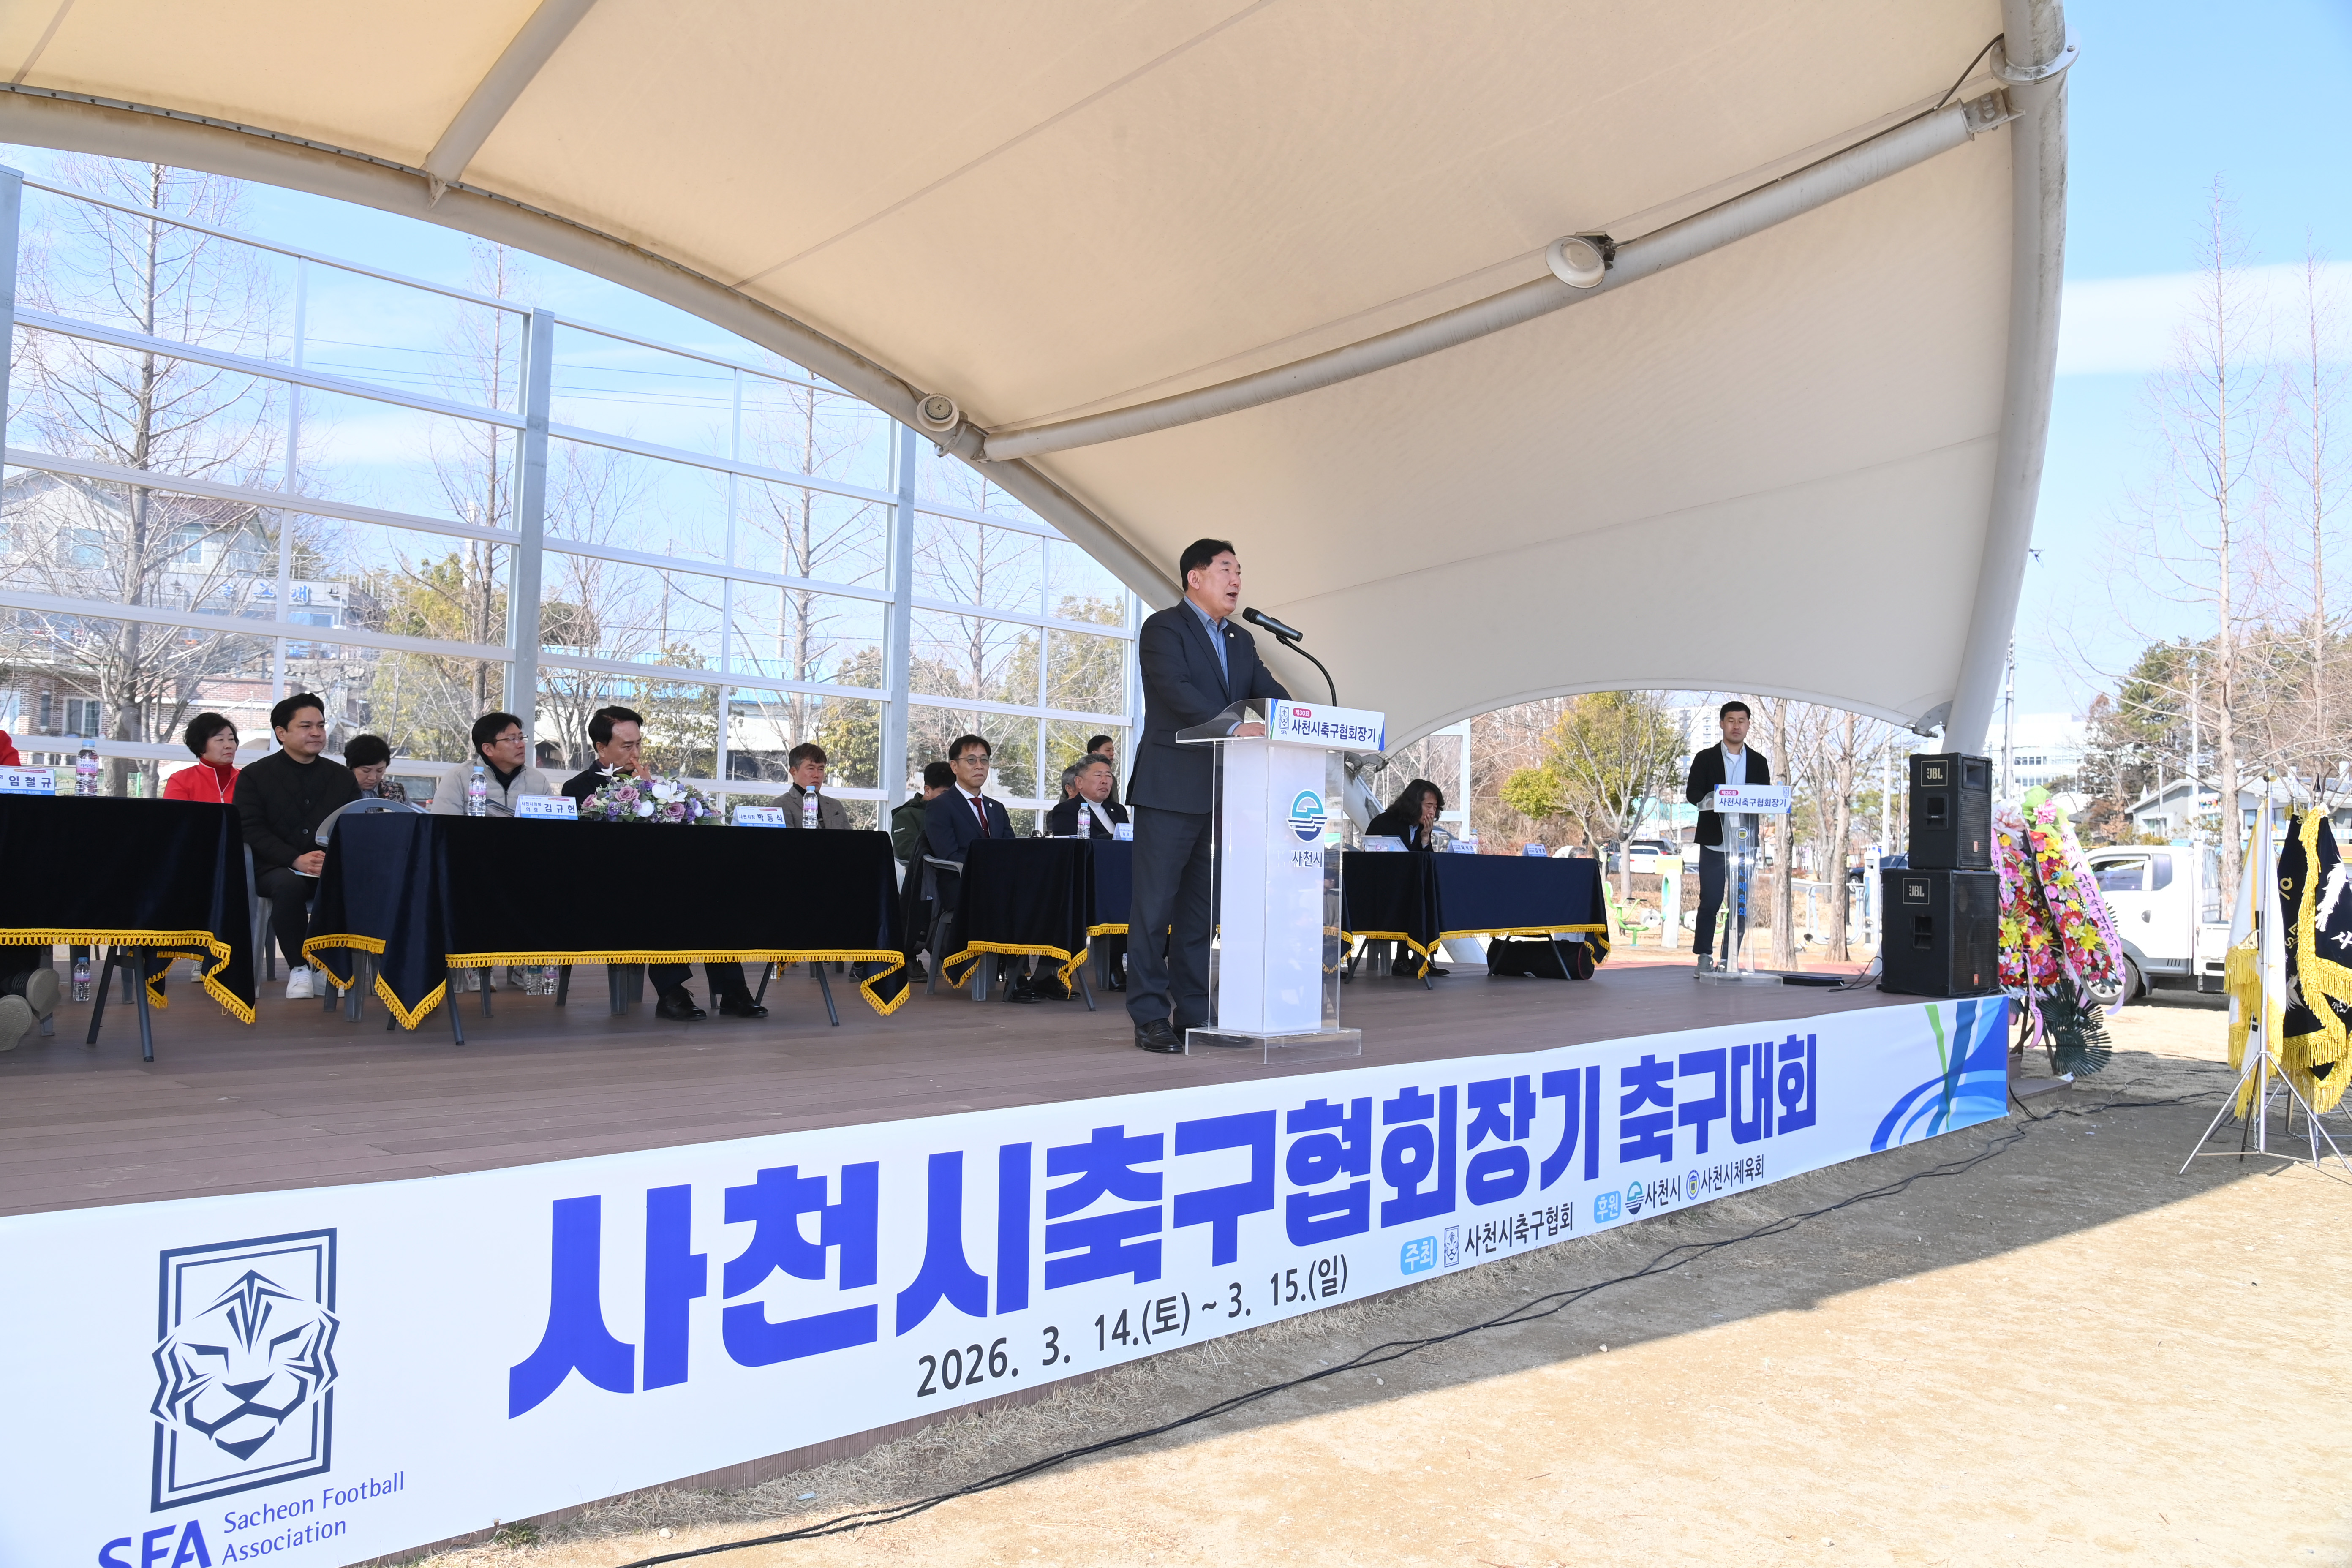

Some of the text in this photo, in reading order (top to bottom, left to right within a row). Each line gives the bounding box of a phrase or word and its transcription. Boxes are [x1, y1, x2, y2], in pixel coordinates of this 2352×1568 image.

[1295, 709, 1309, 717] 제30회
[1292, 719, 1376, 743] 사천시축구협회장기
[9, 776, 52, 788] 임철규
[1927, 768, 1943, 779] JBL
[544, 804, 575, 814] 김규헌
[1719, 798, 1786, 807] 사천시축구협회장기
[757, 814, 783, 822] 박동식
[1292, 850, 1322, 867] 사천시
[1909, 885, 1925, 897] JBL
[1597, 1154, 1764, 1220] 후원 사천시 사천시체육회
[509, 1034, 1816, 1419] 사천시축구협회장기 축구대회
[1405, 1201, 1573, 1271] 주최 사천시축구협회
[917, 1337, 1018, 1397] 2026.
[1042, 1326, 1070, 1366] 3.
[1094, 1292, 1190, 1351] 14.(토)
[1228, 1282, 1251, 1318] 3.
[1271, 1254, 1348, 1306] 15.(일)
[224, 1471, 404, 1533] Sacheon Football
[98, 1519, 346, 1568] SFA Association
